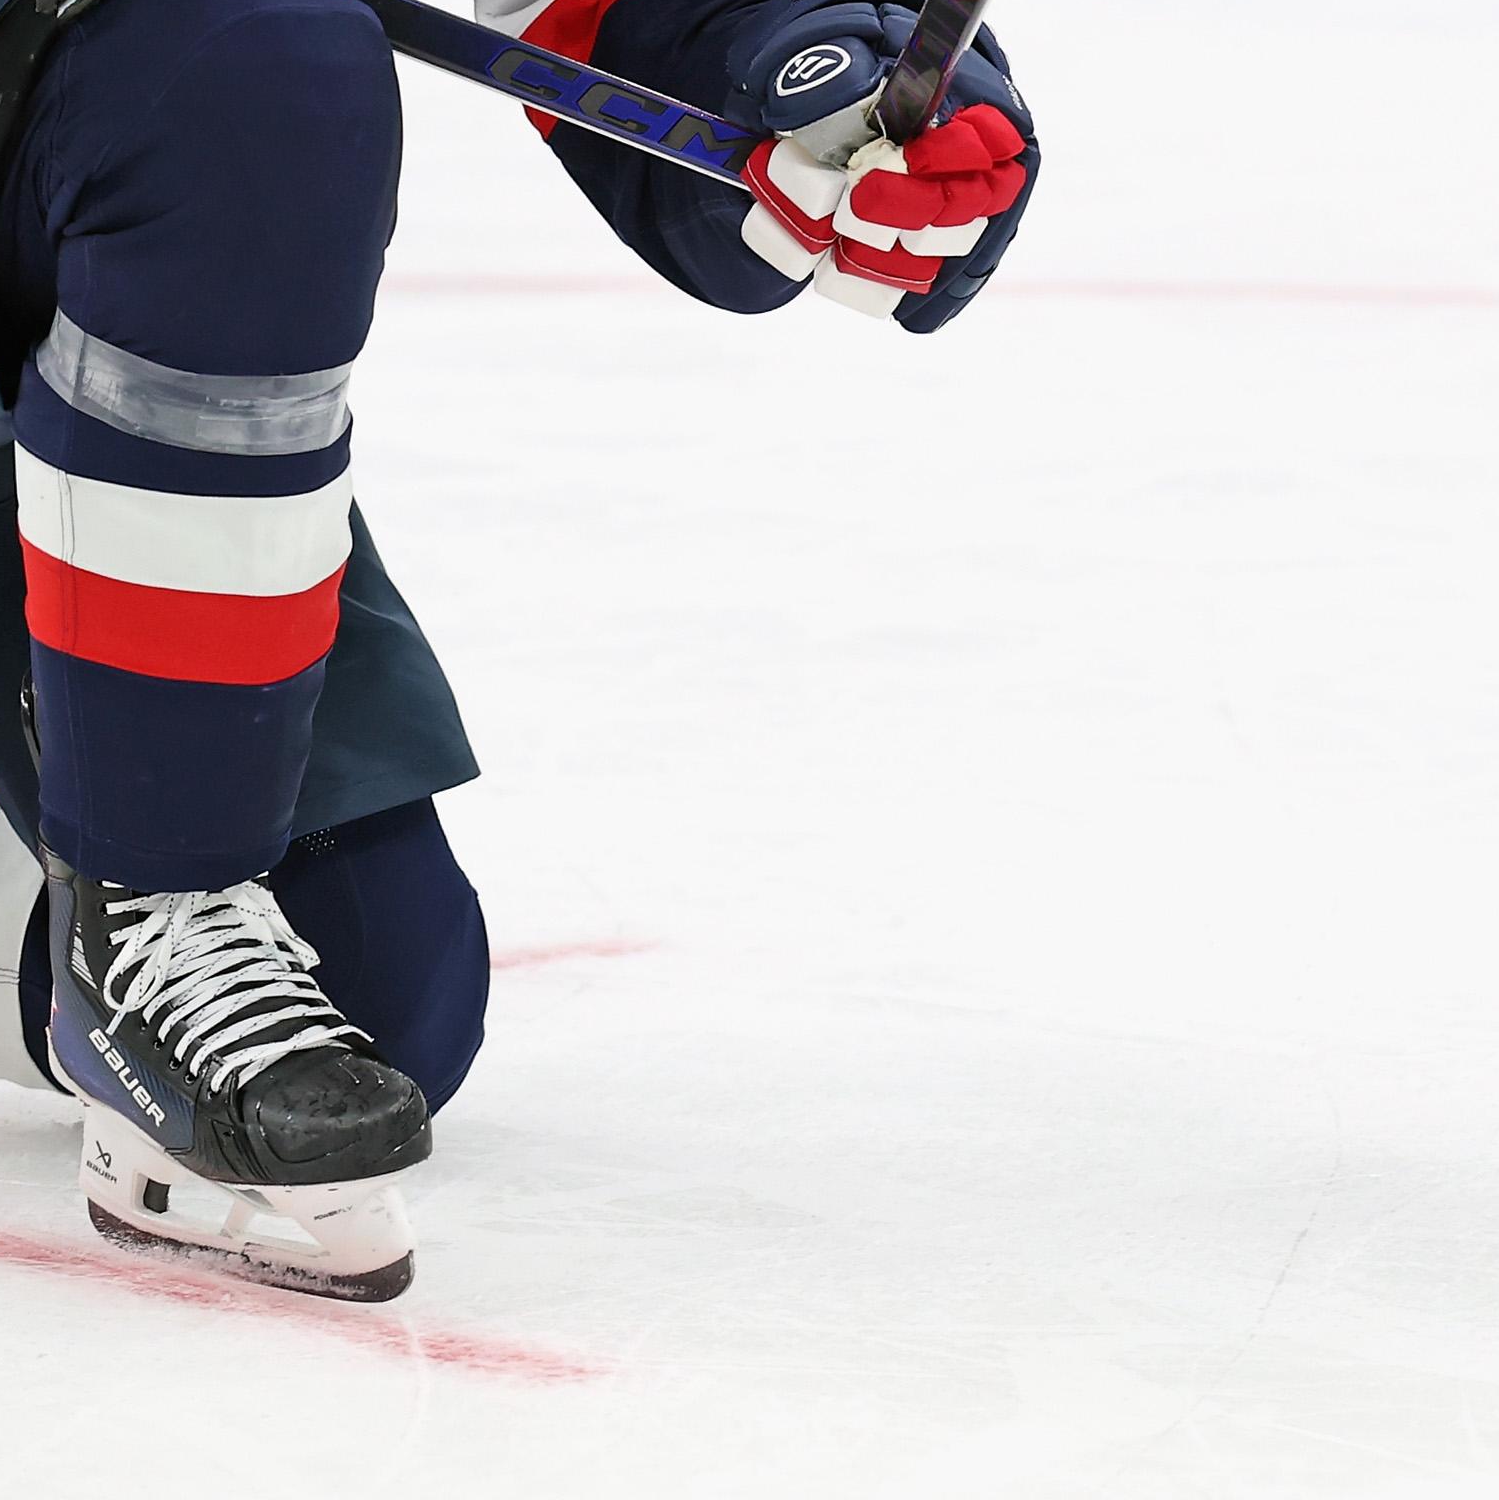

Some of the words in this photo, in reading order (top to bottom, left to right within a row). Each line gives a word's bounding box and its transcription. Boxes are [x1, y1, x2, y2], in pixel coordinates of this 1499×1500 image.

[486, 47, 758, 173] CCM
[88, 1028, 166, 1128] BAUER
[86, 1160, 117, 1184] BAUER
